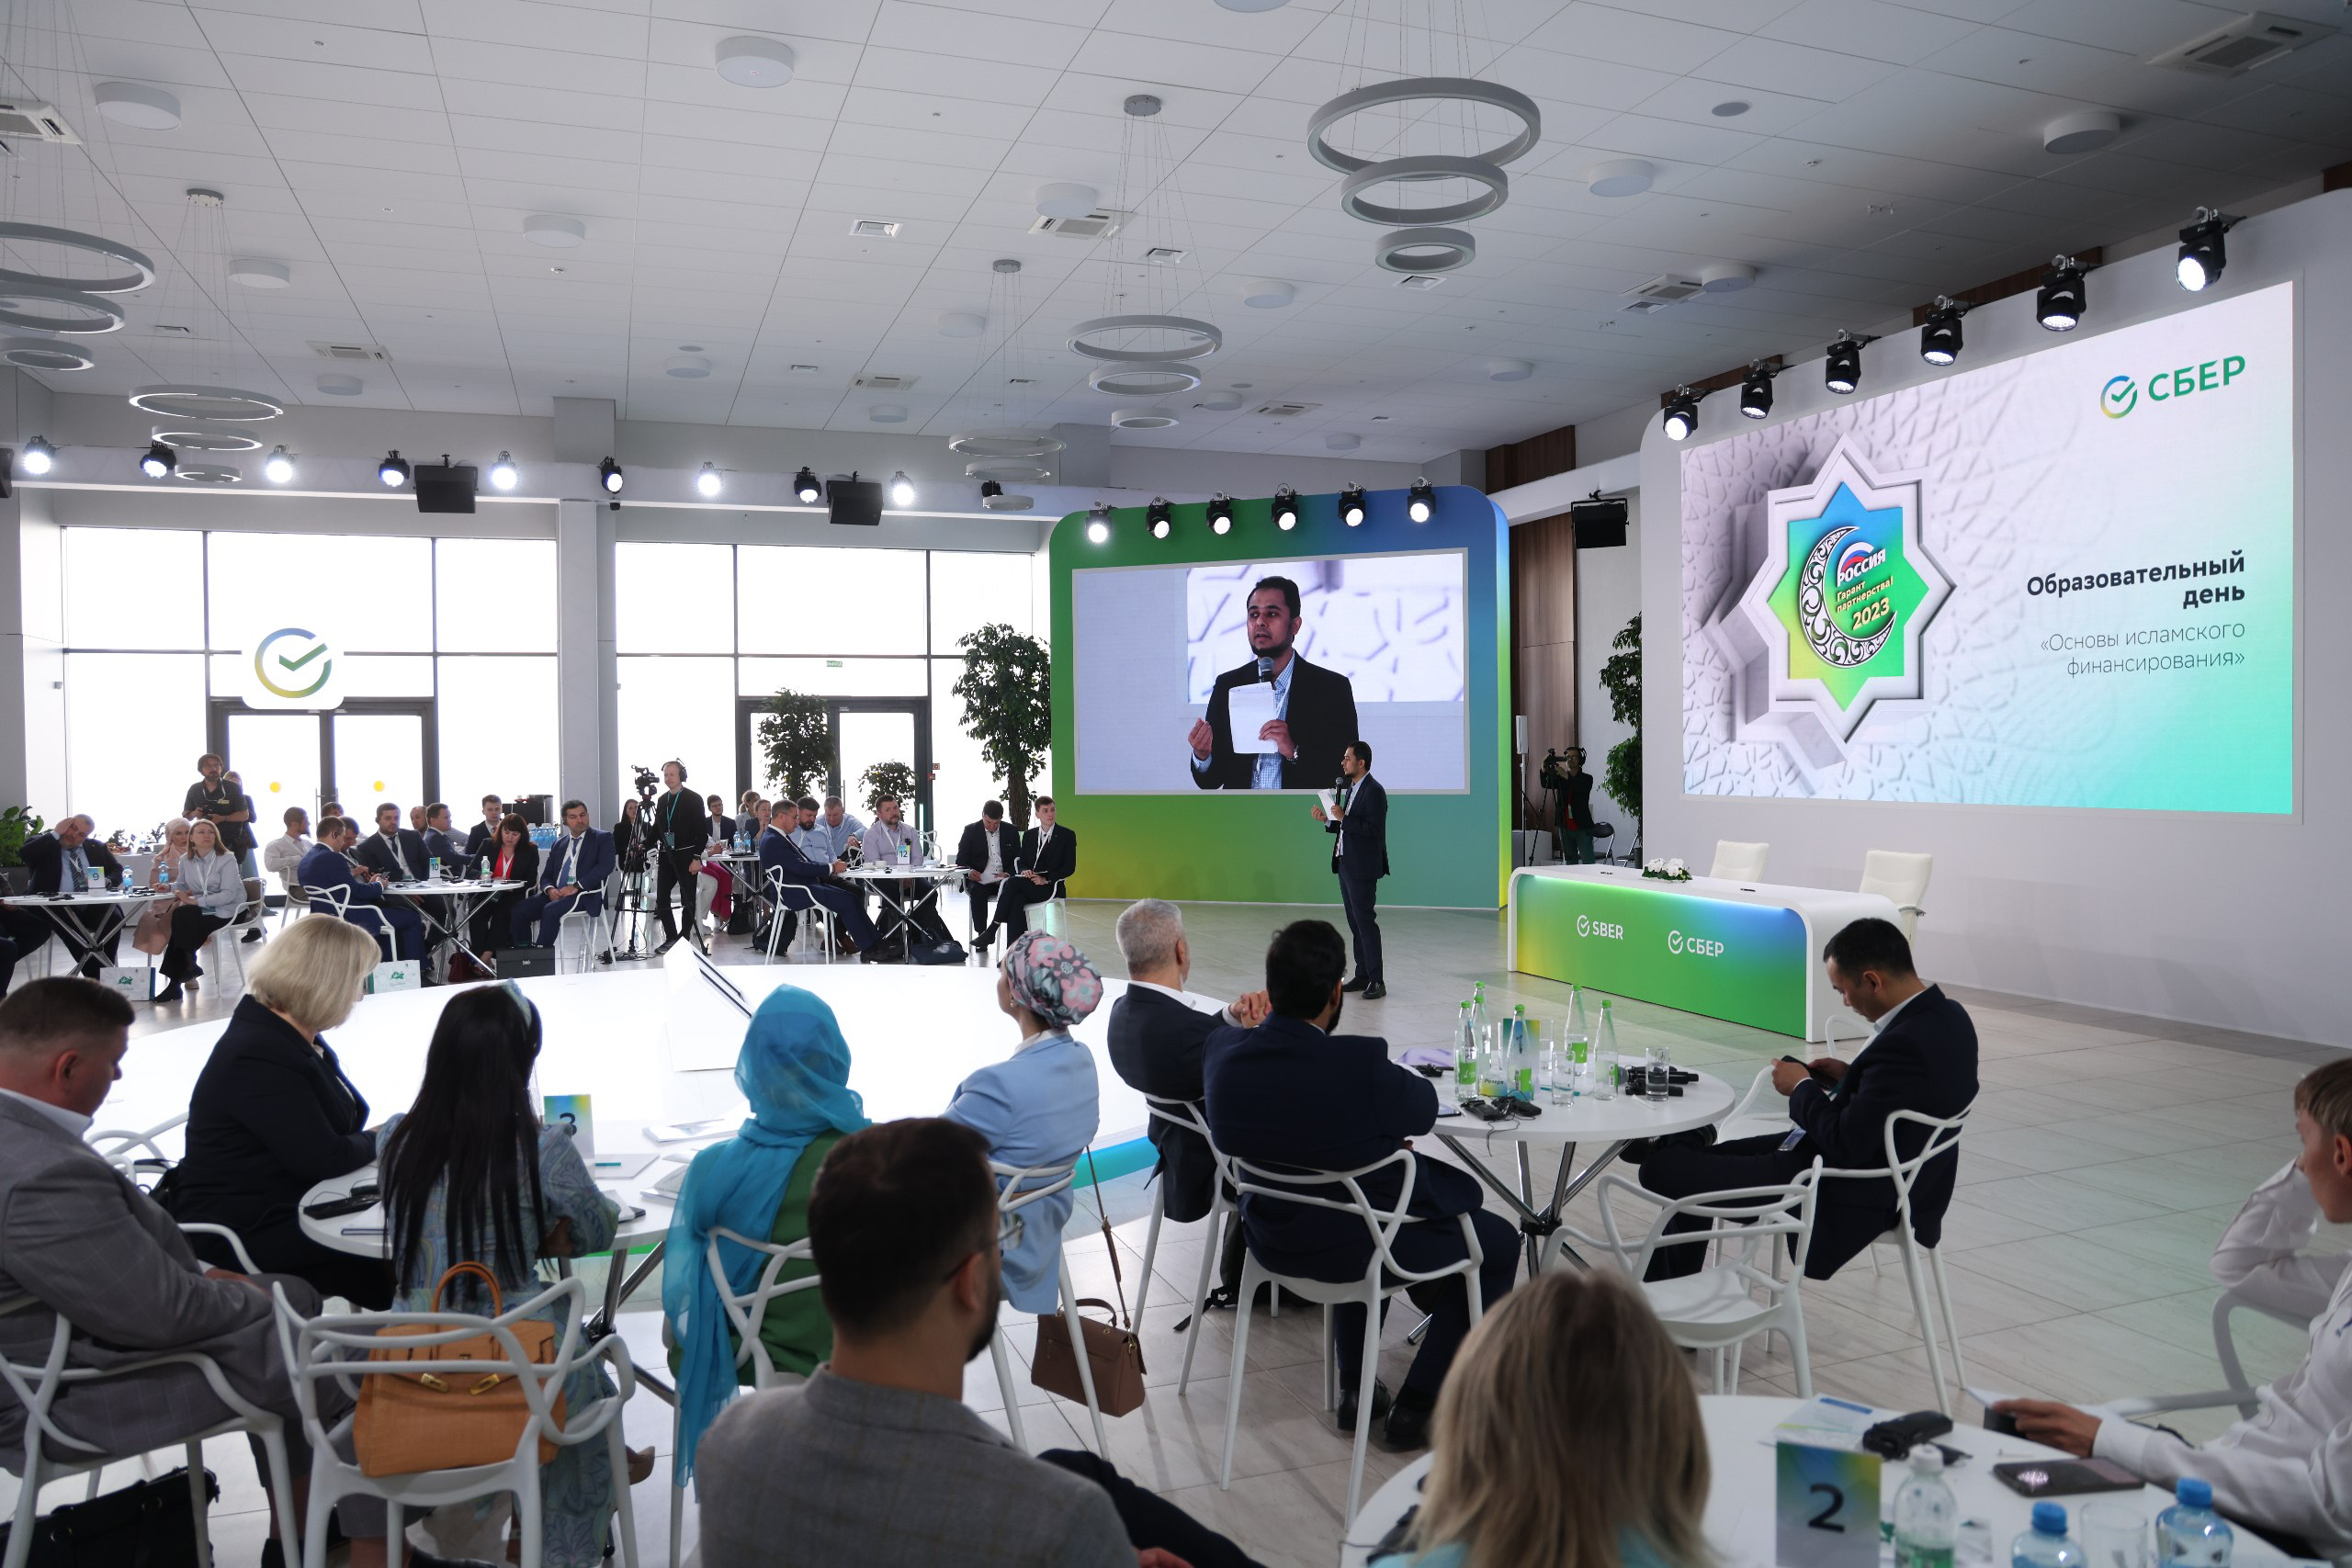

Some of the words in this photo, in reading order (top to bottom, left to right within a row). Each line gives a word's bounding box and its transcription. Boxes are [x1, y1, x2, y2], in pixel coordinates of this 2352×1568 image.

[2148, 355, 2245, 401] СБЕР
[1838, 548, 1886, 587] РОССИЯ
[2027, 549, 2245, 598] Образовательный
[1838, 581, 1865, 602] Гарант
[1838, 576, 1894, 613] партнерства!
[2183, 586, 2245, 609] день
[1853, 597, 1889, 630] 2023
[2041, 632, 2119, 651] «Основы
[2126, 623, 2245, 645] исламского
[2067, 650, 2245, 678] финансирования»
[1592, 920, 1623, 941] SBER
[1687, 937, 1724, 957] СБЕР
[1808, 1483, 1846, 1533] 2
